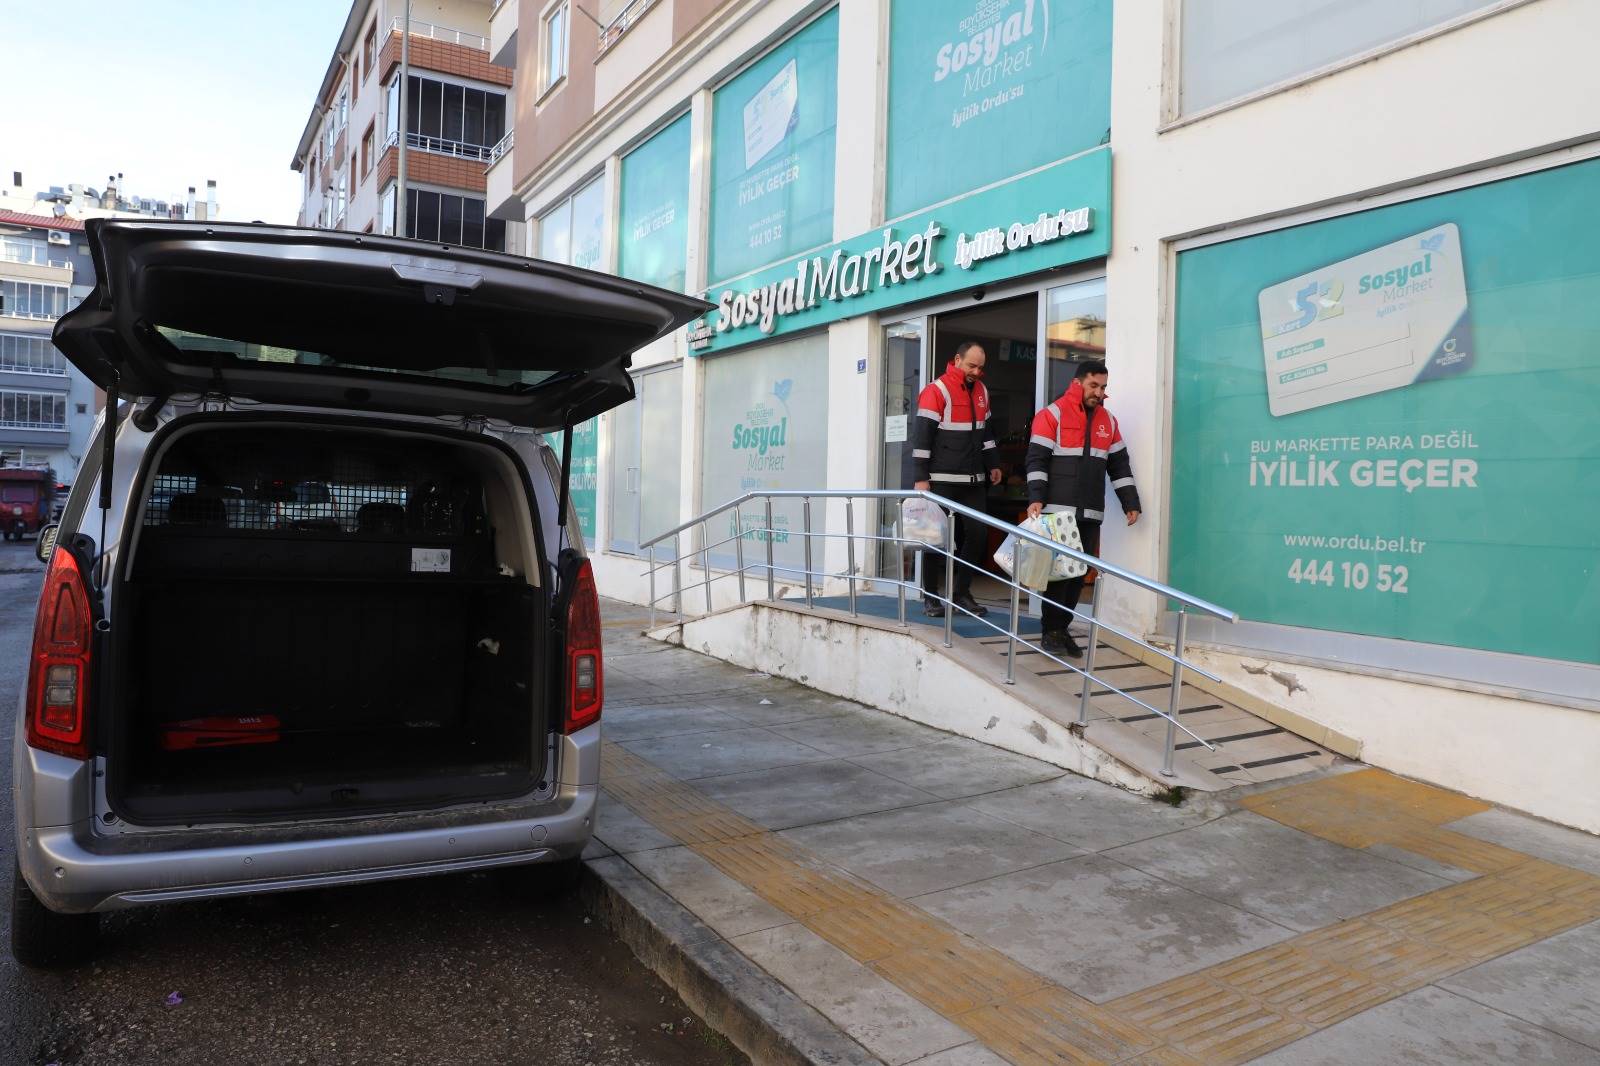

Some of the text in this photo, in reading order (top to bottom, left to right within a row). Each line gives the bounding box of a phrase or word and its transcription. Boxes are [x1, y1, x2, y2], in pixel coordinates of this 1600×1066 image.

[934, 0, 1034, 82] Sosyal
[963, 43, 1033, 97] Market
[954, 233, 1005, 270] İyilik
[1007, 207, 1089, 251] Ordu'su
[1359, 253, 1433, 294] Sosyal
[1383, 276, 1434, 304] Market
[732, 417, 786, 456] Sosyal
[1251, 430, 1479, 453] BU MARKETTE PARA DEĞİL
[748, 453, 785, 471] Market
[1250, 454, 1478, 493] İYİLİK GEÇER
[1284, 534, 1426, 554] www.ordu.bel.tr
[1287, 558, 1409, 594] 444 10 52
